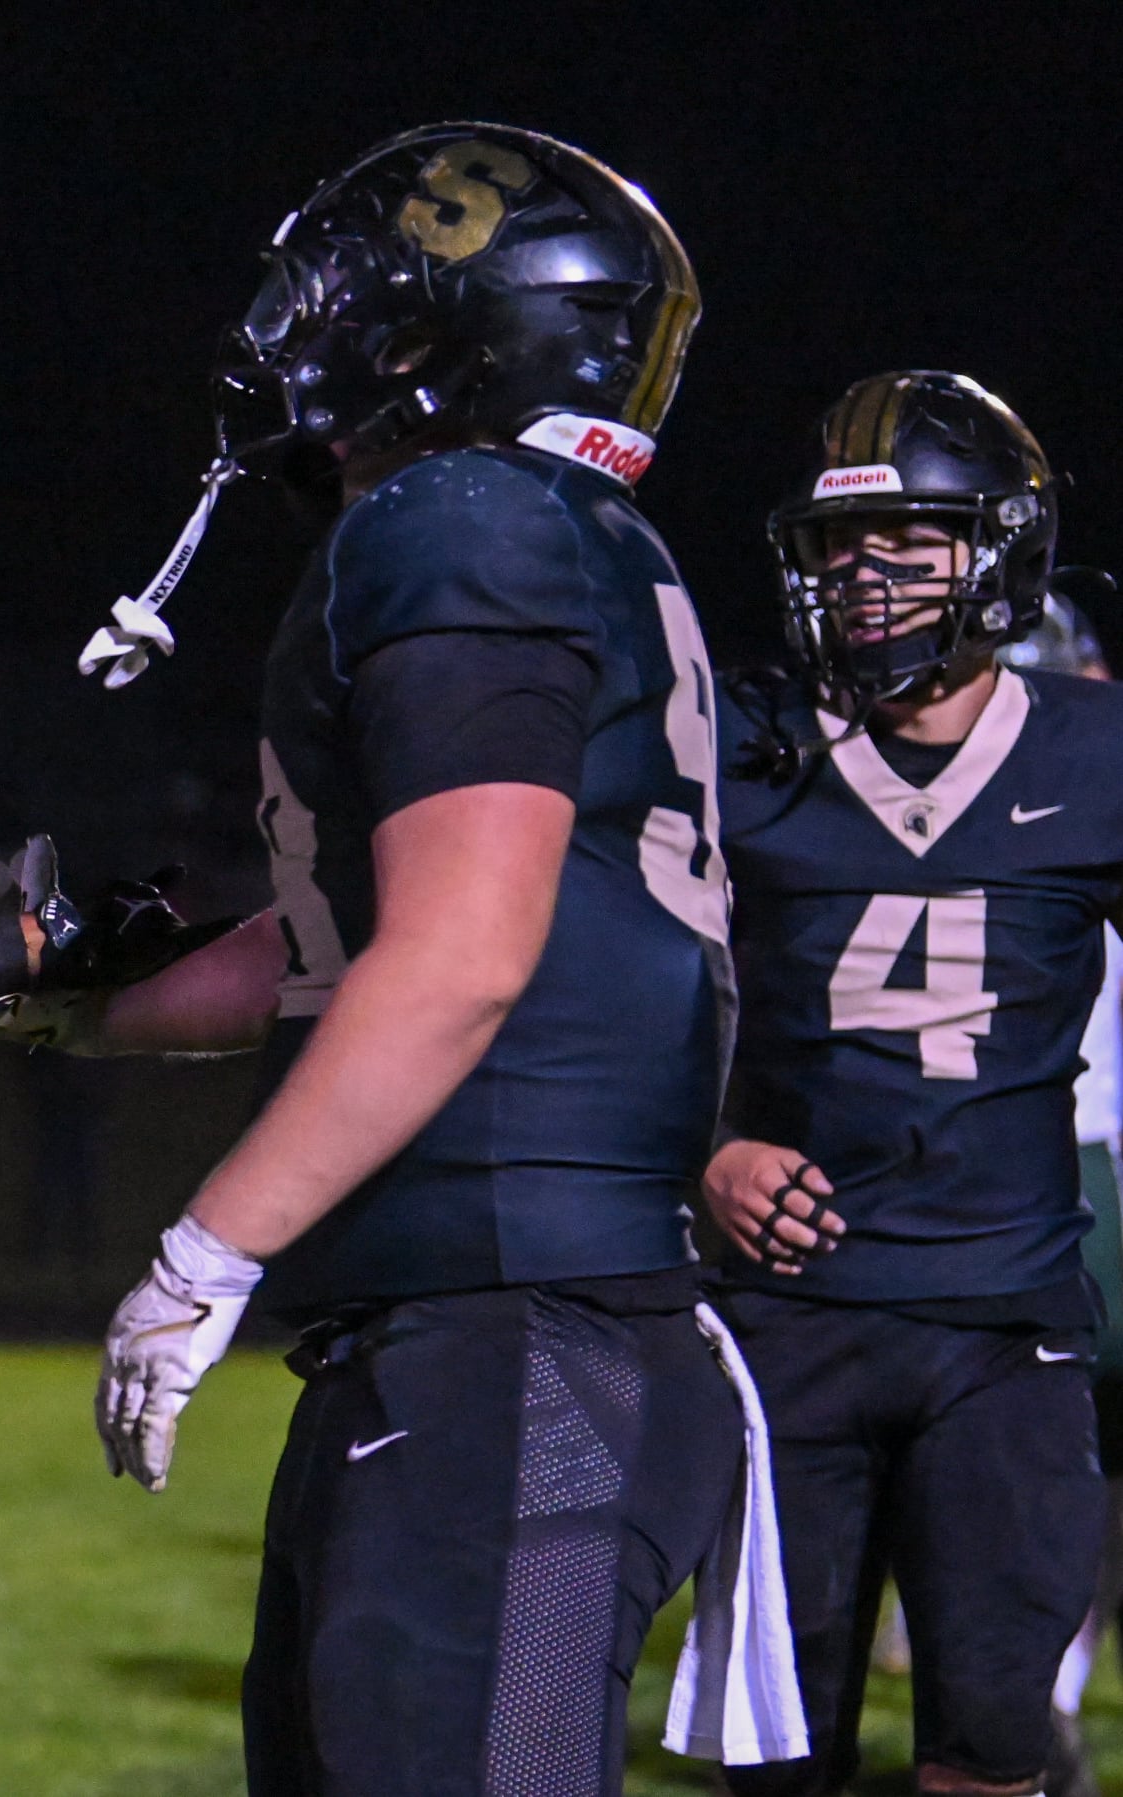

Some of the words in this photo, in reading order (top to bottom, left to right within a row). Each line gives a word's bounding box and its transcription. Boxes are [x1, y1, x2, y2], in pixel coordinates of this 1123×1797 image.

[398, 140, 533, 262] S
[823, 472, 888, 488] Riddell
[148, 544, 193, 604] NXTRND
[829, 889, 997, 1080] 4
